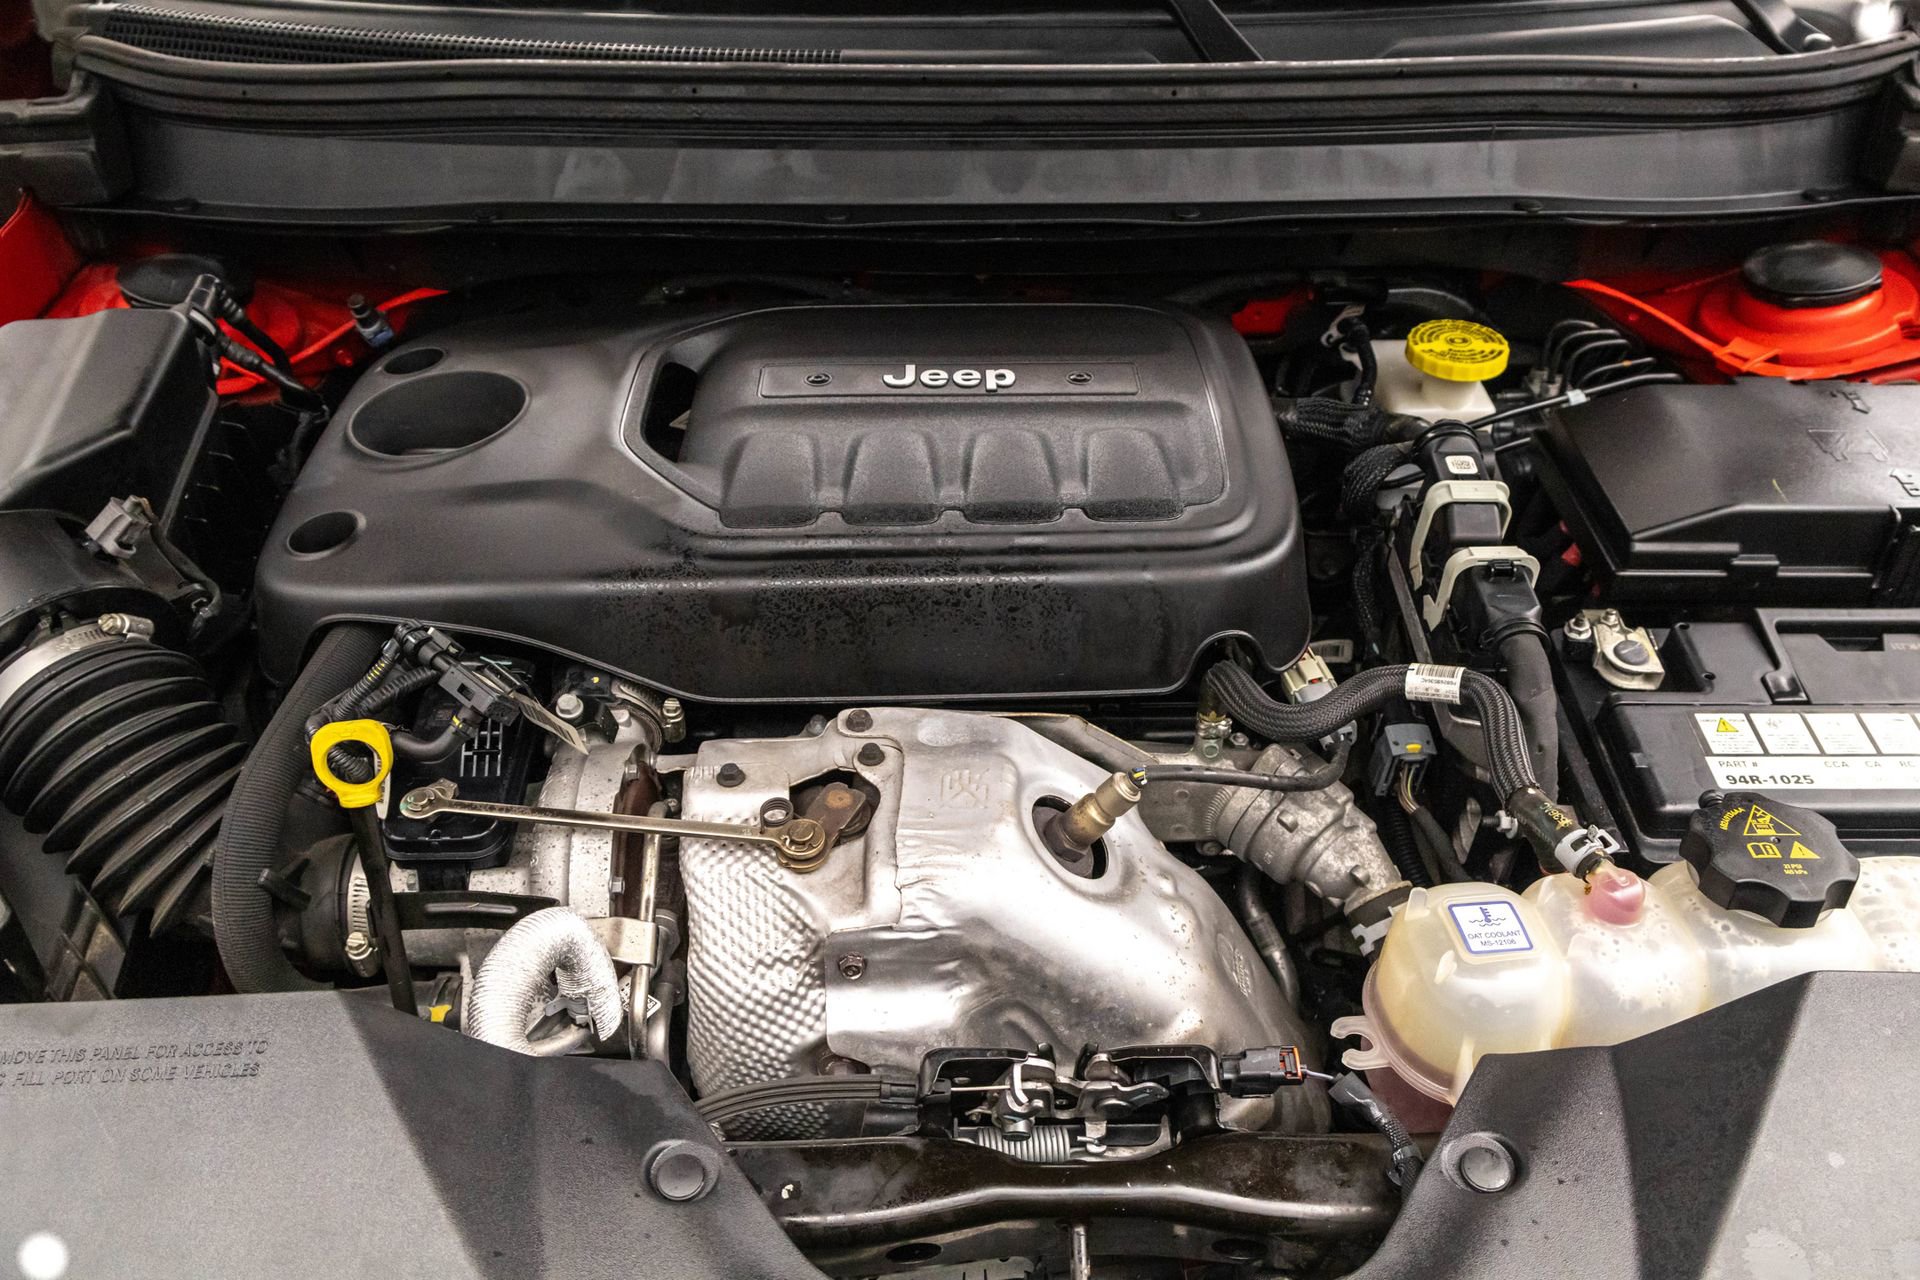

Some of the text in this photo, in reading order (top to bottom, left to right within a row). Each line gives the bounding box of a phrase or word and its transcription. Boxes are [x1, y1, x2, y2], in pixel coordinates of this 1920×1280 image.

[882, 363, 1017, 393] Jeep
[1718, 760, 1748, 768] PART
[1824, 760, 1850, 768] CCA
[1864, 760, 1882, 768] CA
[1725, 774, 1815, 785] 94R-1025
[1467, 930, 1520, 940] OAT COOLANT
[1480, 938, 1517, 947] MS-12106
[50, 1047, 87, 1063] THIS
[89, 1045, 140, 1061] PANEL
[145, 1044, 178, 1059] FOR
[179, 1041, 243, 1057] ACCESS
[247, 1040, 270, 1055] TO
[12, 1071, 45, 1087] FILL
[51, 1069, 97, 1085] PORT
[100, 1067, 127, 1083] ON
[128, 1065, 177, 1081] SOME
[184, 1061, 261, 1079] VEHICLES
